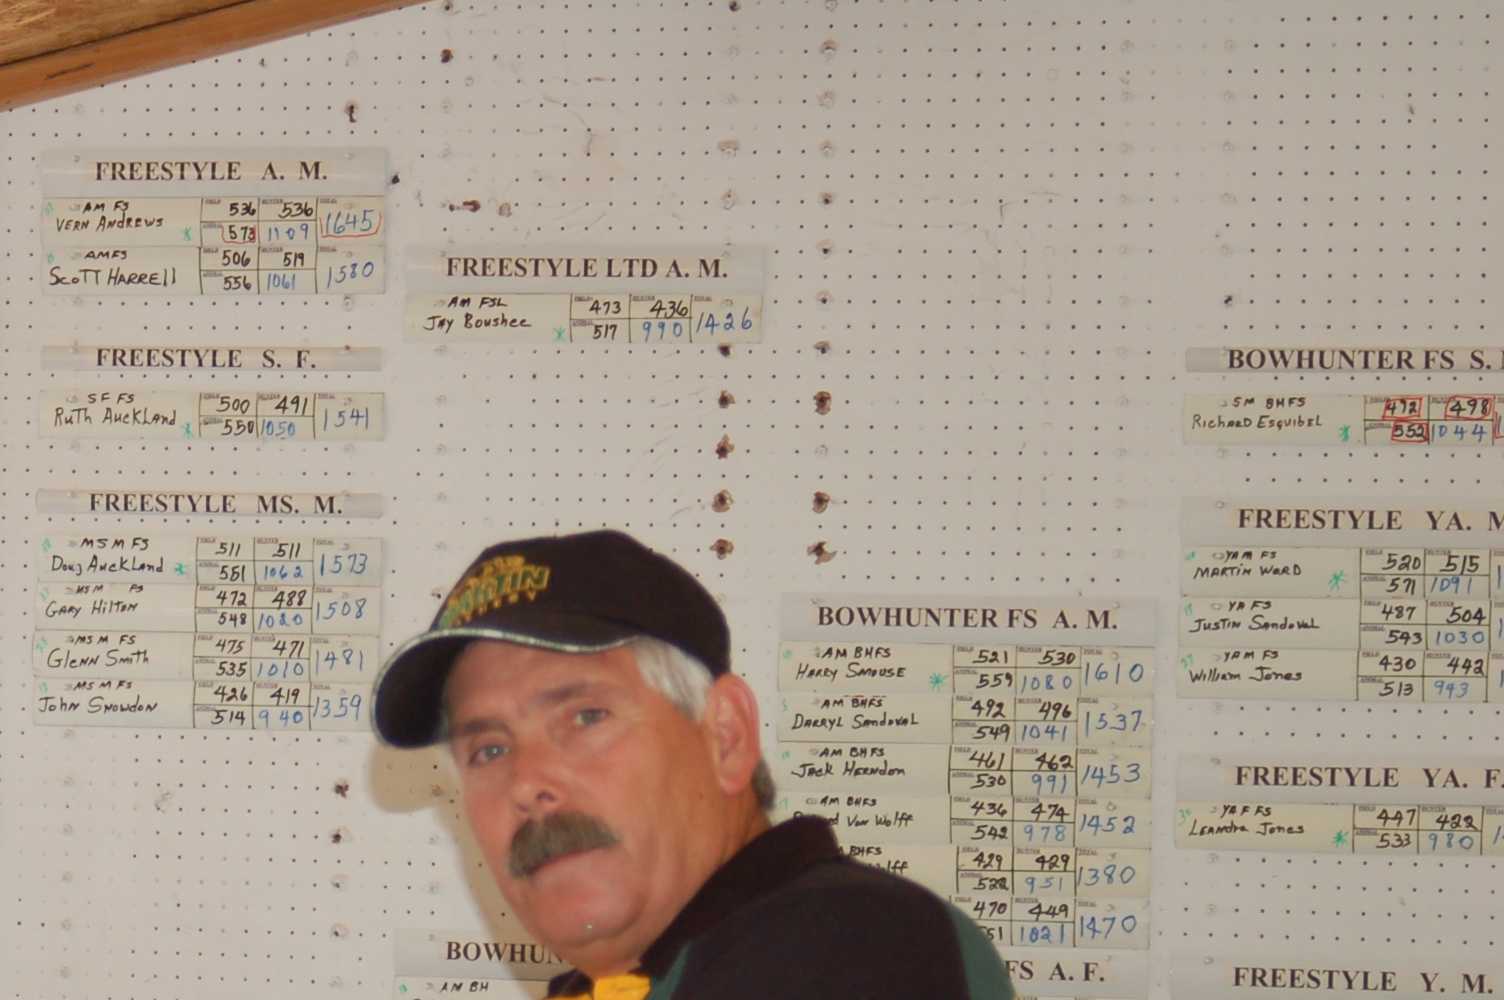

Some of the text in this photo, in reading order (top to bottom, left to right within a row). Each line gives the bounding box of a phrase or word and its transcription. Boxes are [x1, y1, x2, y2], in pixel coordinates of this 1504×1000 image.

[95, 161, 327, 180] FREESTYLE A. M.
[223, 253, 250, 266] 506
[446, 258, 727, 278] FREESTYLE LTD A. M.
[327, 262, 373, 288] 1580
[696, 307, 752, 334] 1426
[593, 324, 617, 340] 517
[643, 322, 683, 342] 990
[96, 349, 315, 369] FREESTYLE S. F.
[1228, 350, 1491, 370] BOWHUNTER FS S.
[217, 397, 249, 414] 500
[275, 396, 307, 416] 491
[324, 407, 369, 430] 1541
[221, 420, 254, 435] 550
[261, 419, 296, 437] 1050
[90, 493, 342, 514] FREESTYLE MS. M.
[1237, 509, 1472, 531] FREESTYLE YA.
[1383, 553, 1421, 571] 520
[1440, 555, 1480, 575] 515
[264, 565, 303, 580] 1062
[1386, 578, 1416, 595] 571
[1431, 577, 1472, 594] 1091
[217, 592, 247, 606] 472
[272, 590, 306, 607] 488
[316, 599, 367, 620] 1508
[817, 606, 1118, 630] BOWHUNTER FS A. M.
[1382, 604, 1416, 622] 487
[1447, 608, 1486, 624] 504
[218, 612, 247, 626] 548
[1385, 630, 1422, 645] 543
[1435, 630, 1485, 645] 1030
[273, 641, 304, 658] 471
[973, 650, 1008, 664] 521
[1037, 650, 1076, 665] 530
[218, 661, 247, 676] 535
[258, 661, 304, 679] 1010
[1379, 655, 1416, 670] 430
[1447, 658, 1484, 675] 442
[1085, 662, 1144, 686] 1610
[1249, 666, 1302, 681] Jones
[1022, 676, 1072, 694] 1080
[1379, 682, 1414, 698] 513
[214, 686, 248, 702] 426
[212, 710, 245, 725] 514
[971, 702, 1006, 718] 492
[1039, 701, 1072, 719] 496
[974, 724, 1010, 740] 549
[1022, 724, 1067, 741] 1041
[968, 753, 1004, 770] 461
[1035, 754, 1074, 771] 462
[972, 774, 1007, 789] 530
[1032, 774, 1067, 795] 991
[1082, 764, 1140, 789] 1453
[1234, 766, 1399, 788] FREESTYLE
[1422, 768, 1468, 788] YA.
[1031, 802, 1070, 822] 474
[1376, 808, 1415, 827] 447
[1024, 824, 1066, 842] 978
[1079, 815, 1136, 835] 1452
[1256, 822, 1304, 836] Jones
[1376, 833, 1411, 849] 533
[1429, 833, 1474, 850] 980
[1077, 865, 1135, 886] 1380
[1025, 876, 1062, 893] 951
[973, 901, 1007, 916] 470
[1080, 916, 1137, 939] 1470
[446, 941, 564, 964] BOWHUN
[1049, 962, 1074, 981] A.
[1083, 962, 1105, 982] F.
[1233, 967, 1493, 994] FREESTYLE Y. M.
